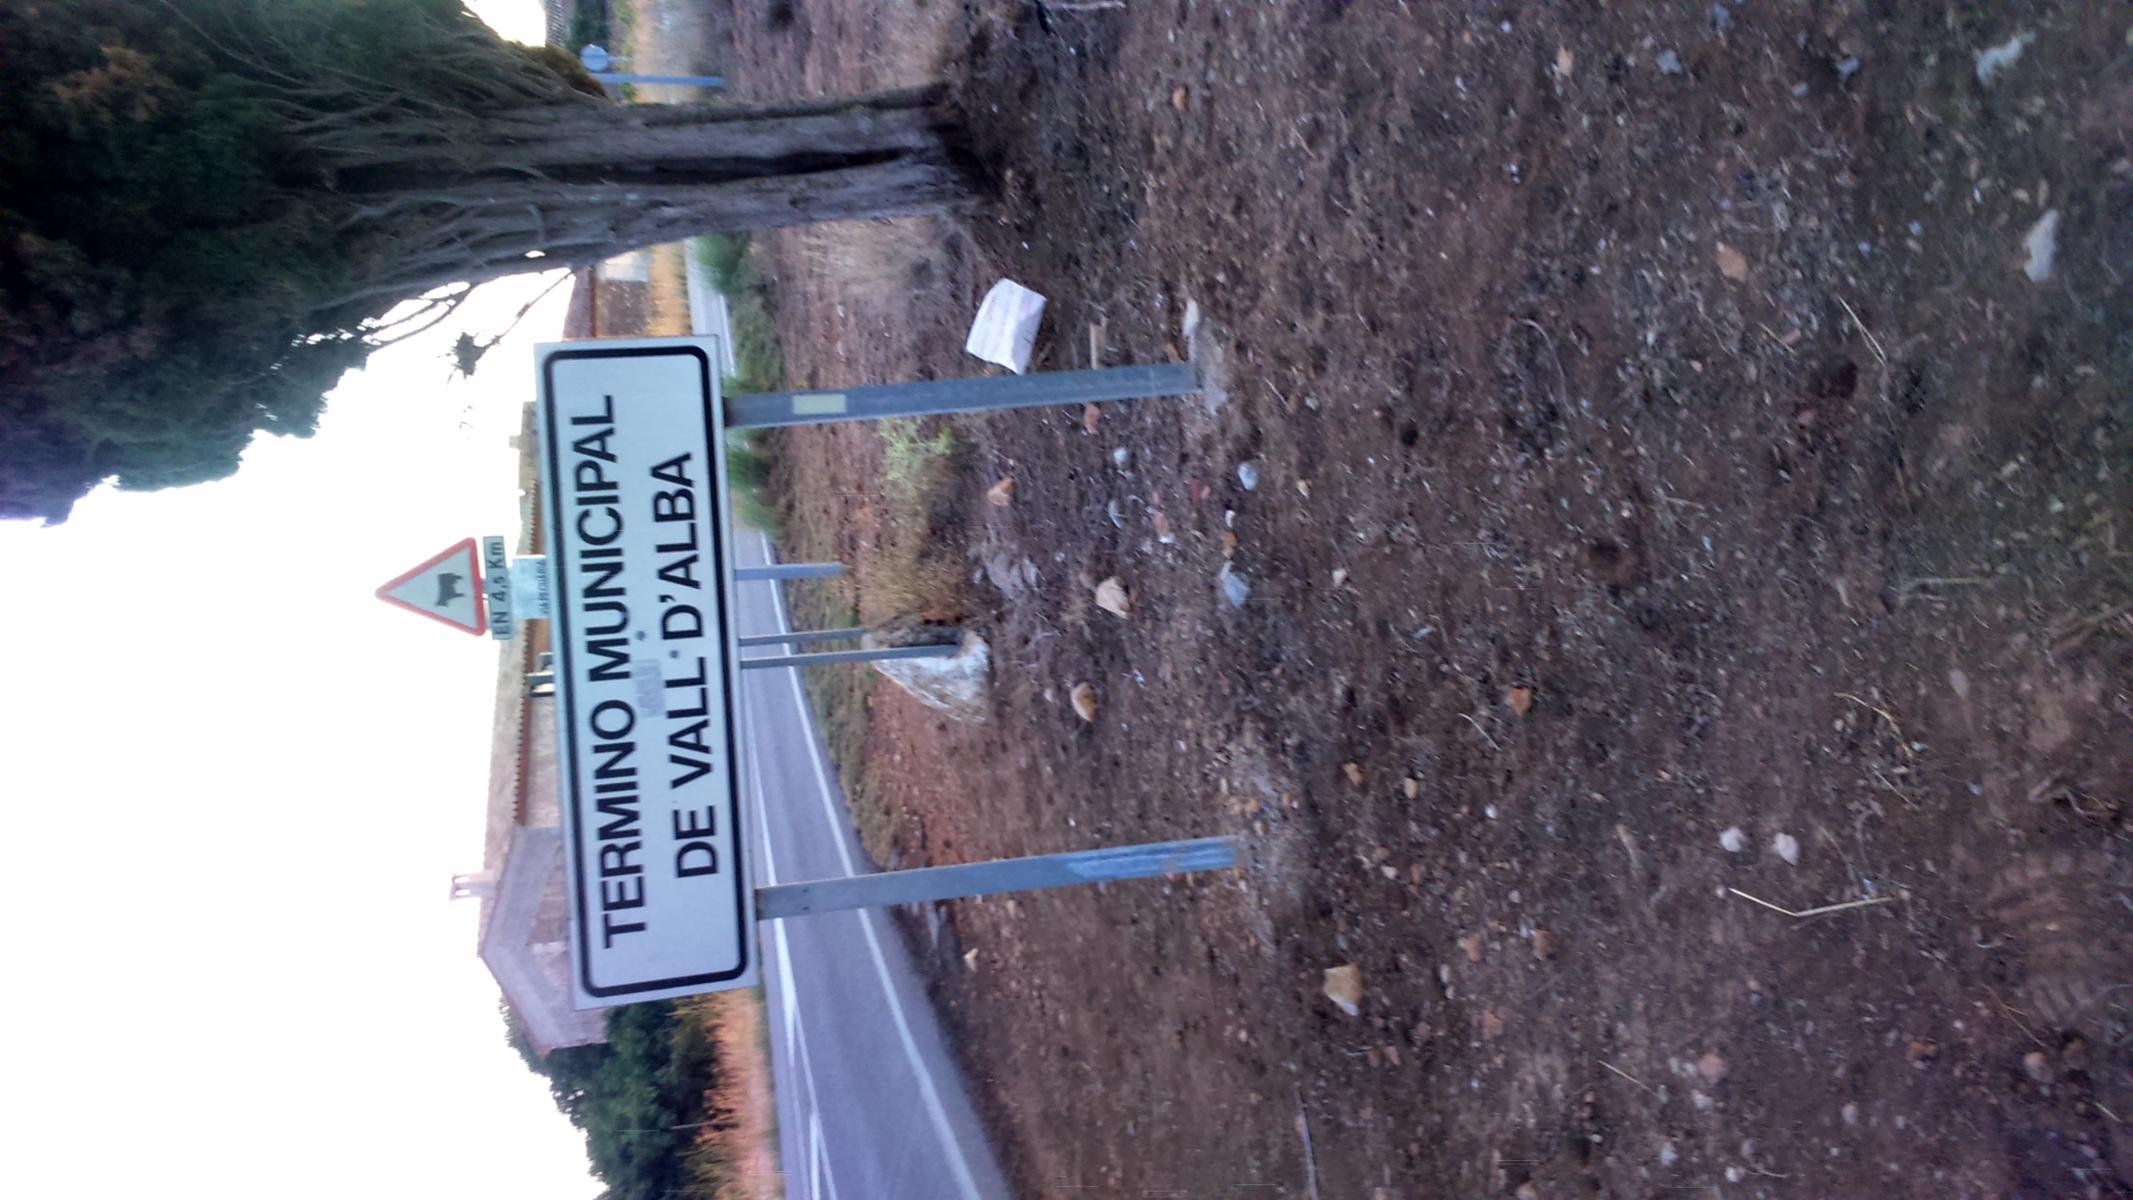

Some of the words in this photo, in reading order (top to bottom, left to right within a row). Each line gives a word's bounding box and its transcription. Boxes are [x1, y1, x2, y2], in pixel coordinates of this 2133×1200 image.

[487, 542, 504, 569] Km
[570, 394, 632, 682] MUNICIPAL
[649, 452, 704, 641] D'ALBA
[491, 611, 511, 636] EN
[664, 656, 713, 790] VALL
[585, 699, 646, 949] TERMINO
[672, 806, 719, 879] DE
